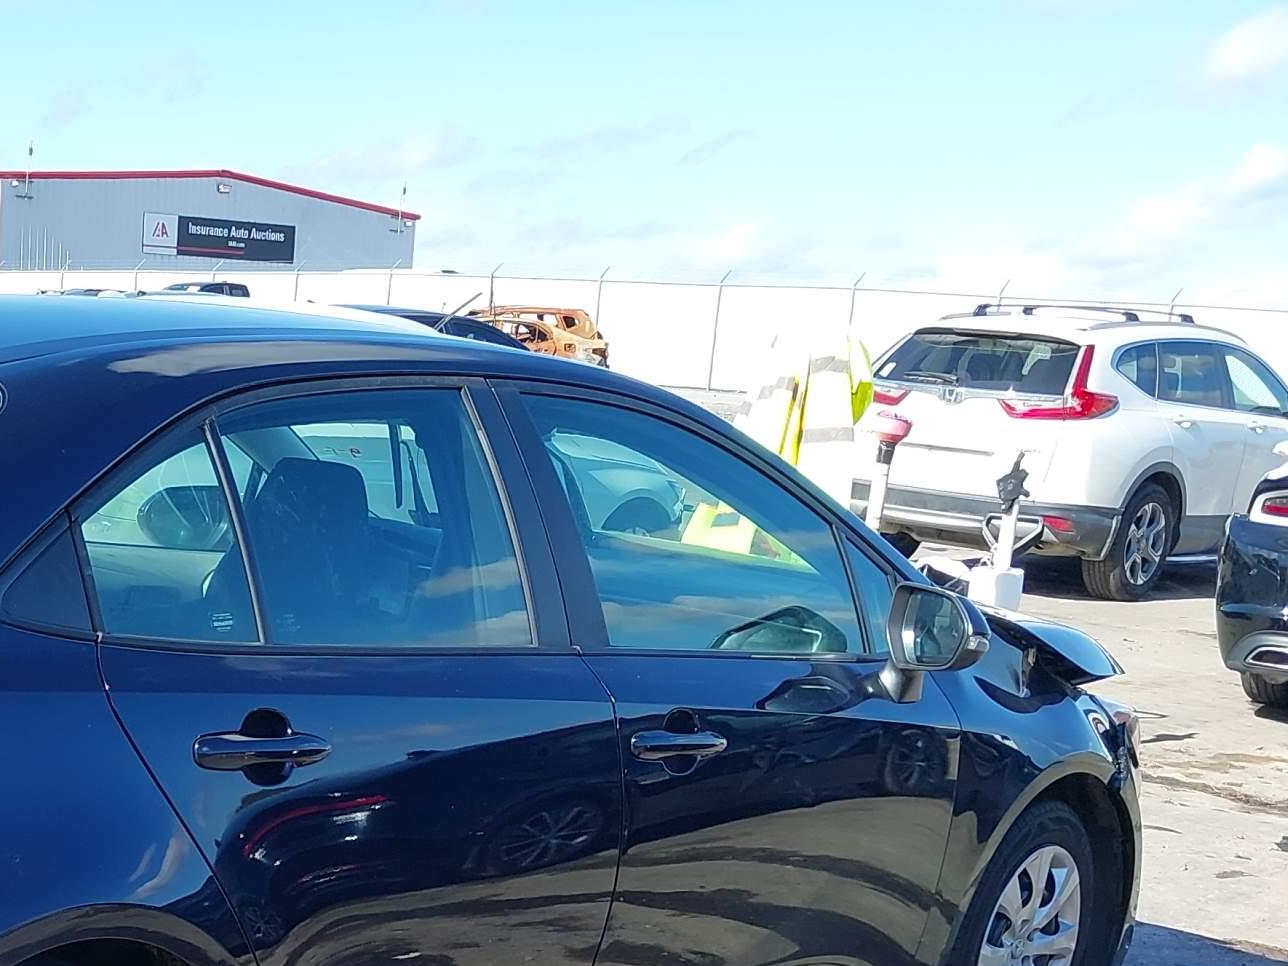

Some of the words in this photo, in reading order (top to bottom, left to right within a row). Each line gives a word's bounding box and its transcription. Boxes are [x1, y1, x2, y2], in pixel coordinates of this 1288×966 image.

[188, 222, 229, 237] Insurance
[230, 226, 249, 239] Auto
[250, 227, 285, 242] Auctions
